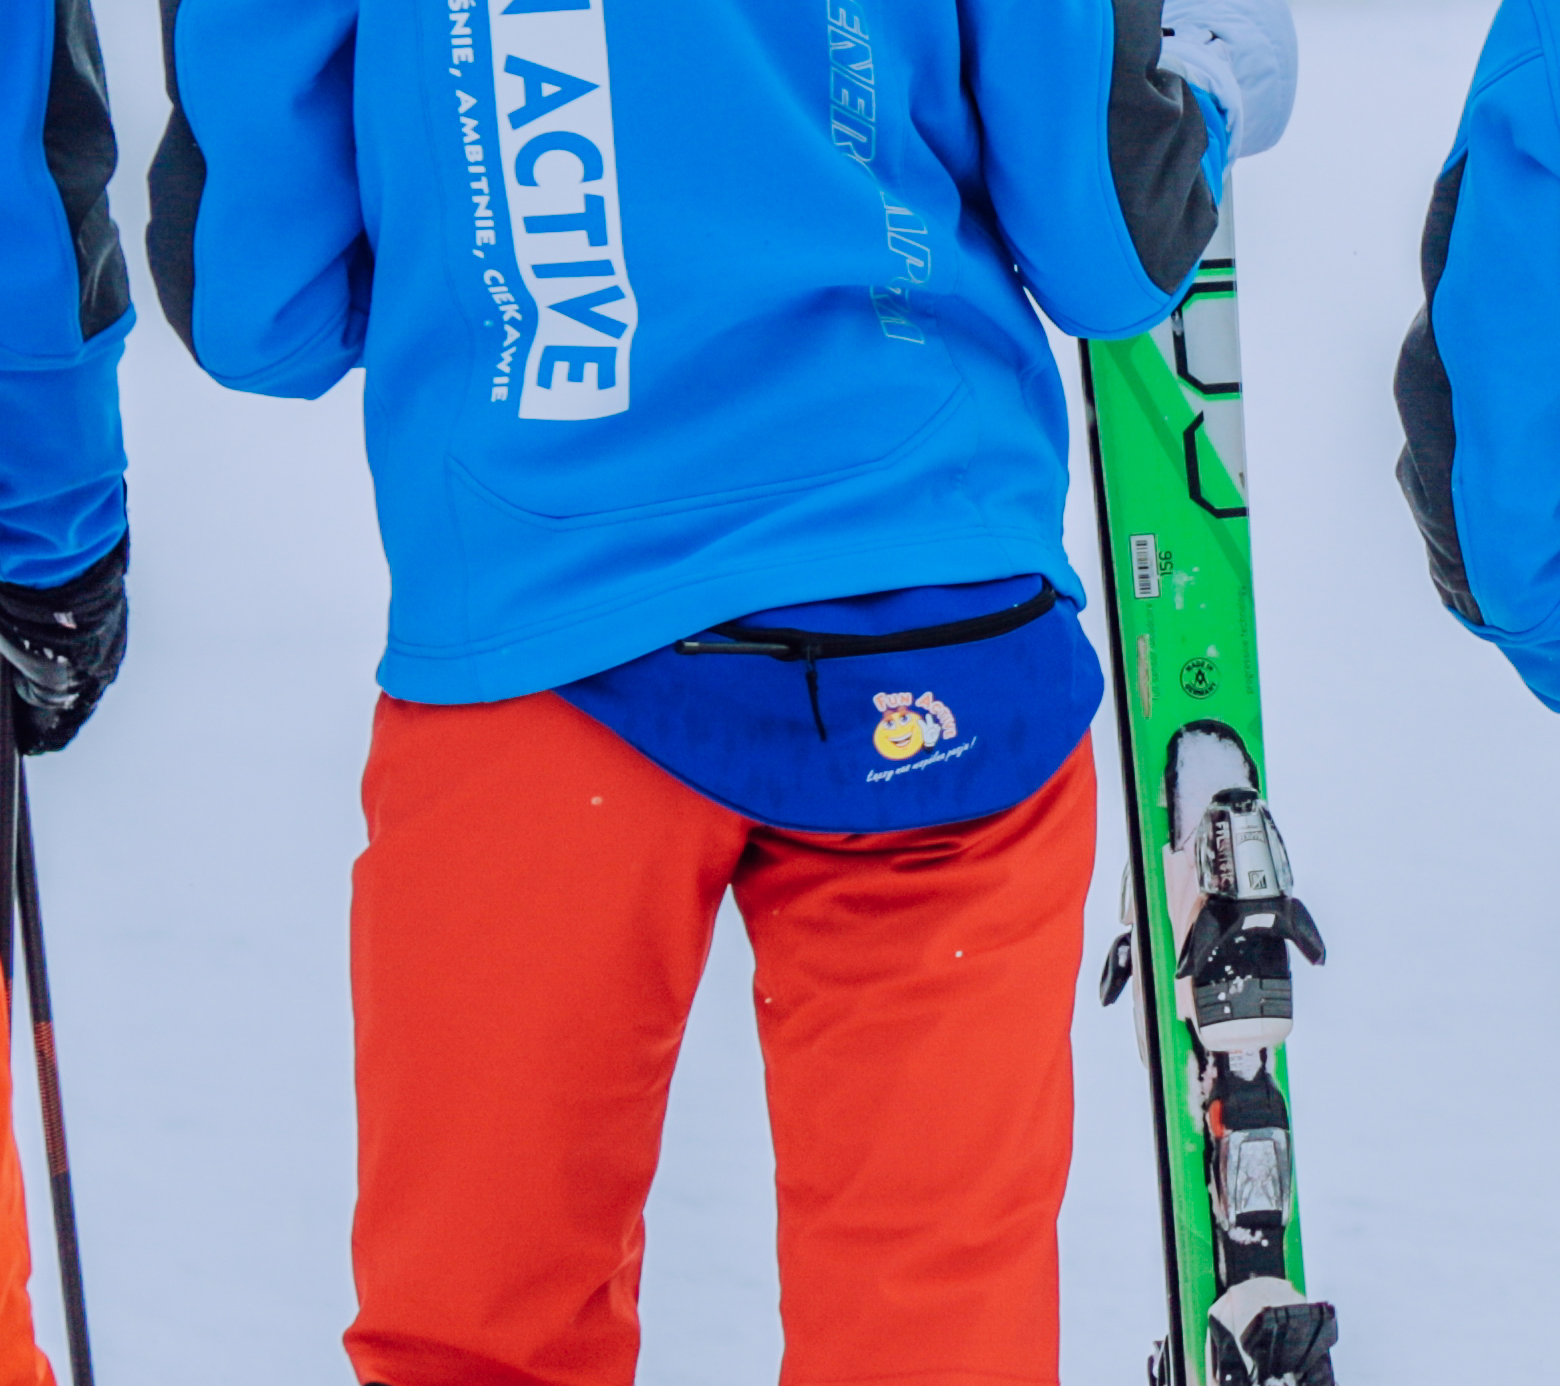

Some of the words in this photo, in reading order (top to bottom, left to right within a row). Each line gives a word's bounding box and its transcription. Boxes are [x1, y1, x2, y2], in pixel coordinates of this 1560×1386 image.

[455, 89, 496, 258] AMBITNIE,
[483, 269, 522, 403] CIEKAWIE
[502, 54, 629, 391] ACTIVE
[1160, 550, 1173, 578] 156
[873, 692, 912, 712] FUN
[915, 691, 957, 740] ACTIVE
